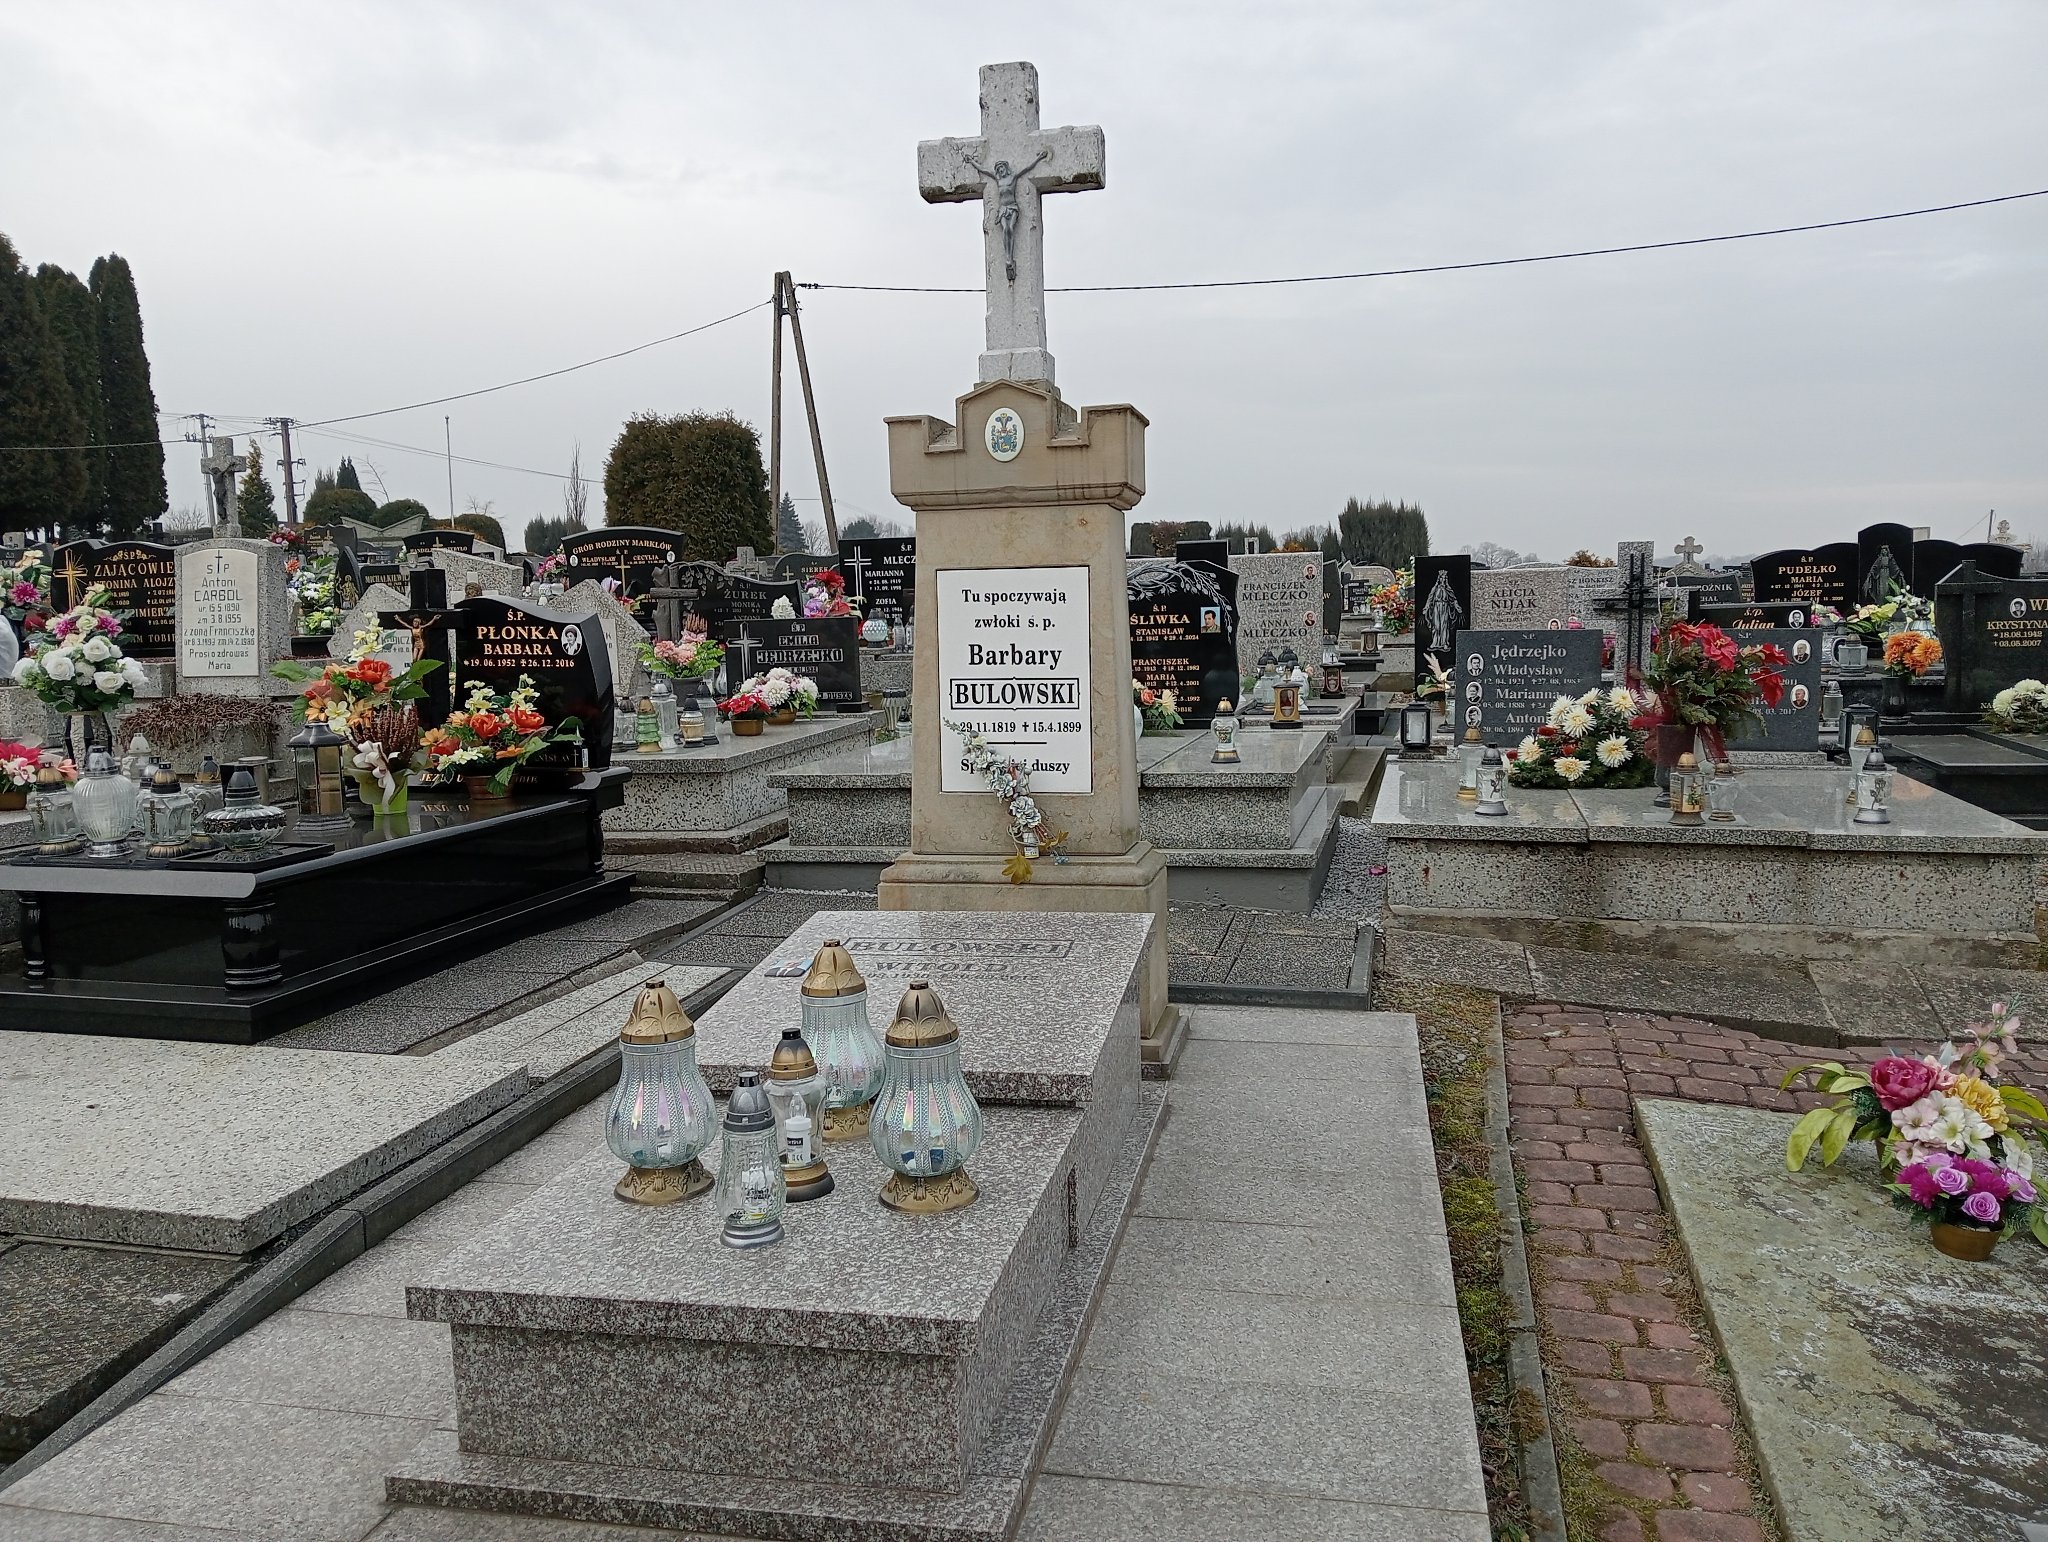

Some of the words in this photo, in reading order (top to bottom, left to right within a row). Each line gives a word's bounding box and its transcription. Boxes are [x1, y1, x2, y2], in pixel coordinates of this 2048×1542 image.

[572, 543, 594, 555] GRÓB
[595, 539, 630, 549] RODZINY
[865, 569, 905, 577] MARIANNA
[1778, 564, 1837, 575] PUDEŁKO
[143, 577, 176, 588] ALOJZ
[202, 577, 236, 588] Antoni
[1790, 575, 1824, 584] MARIA
[1243, 581, 1306, 591] FRANCISZEK
[724, 588, 767, 600] ŻUREK
[961, 589, 980, 603] Tu
[984, 588, 1067, 606] spoczywają
[1242, 590, 1309, 601] MLECZKO
[1491, 588, 1537, 598] ALICJA
[1791, 588, 1823, 597] JÓZEF
[1491, 599, 1538, 610] NIJAK
[507, 608, 526, 621] Ś.P.
[1129, 613, 1191, 625] ŚLIWKA
[974, 614, 1021, 629] zwłoki
[1260, 619, 1289, 628] ANNA
[1986, 620, 2048, 631] KRYSTYNA
[476, 625, 559, 640] PŁONKA
[1243, 627, 1308, 638] MLECZKO
[779, 635, 819, 647] EMILIA
[483, 643, 553, 655] BARBARA
[1491, 644, 1567, 661] Jędrzejko
[757, 648, 843, 665] JĘDRZEJKO
[968, 643, 1063, 670] Barbary
[1132, 658, 1190, 666] FRANCISZEK
[208, 660, 232, 670] Maria
[497, 658, 516, 667] 1952
[555, 658, 575, 668] 2016
[1493, 664, 1565, 678] Władysław
[954, 682, 1075, 705] BULOWSKI
[1496, 688, 1560, 699] Marianna
[1505, 712, 1549, 724] Anton
[1031, 759, 1071, 774] duszy
